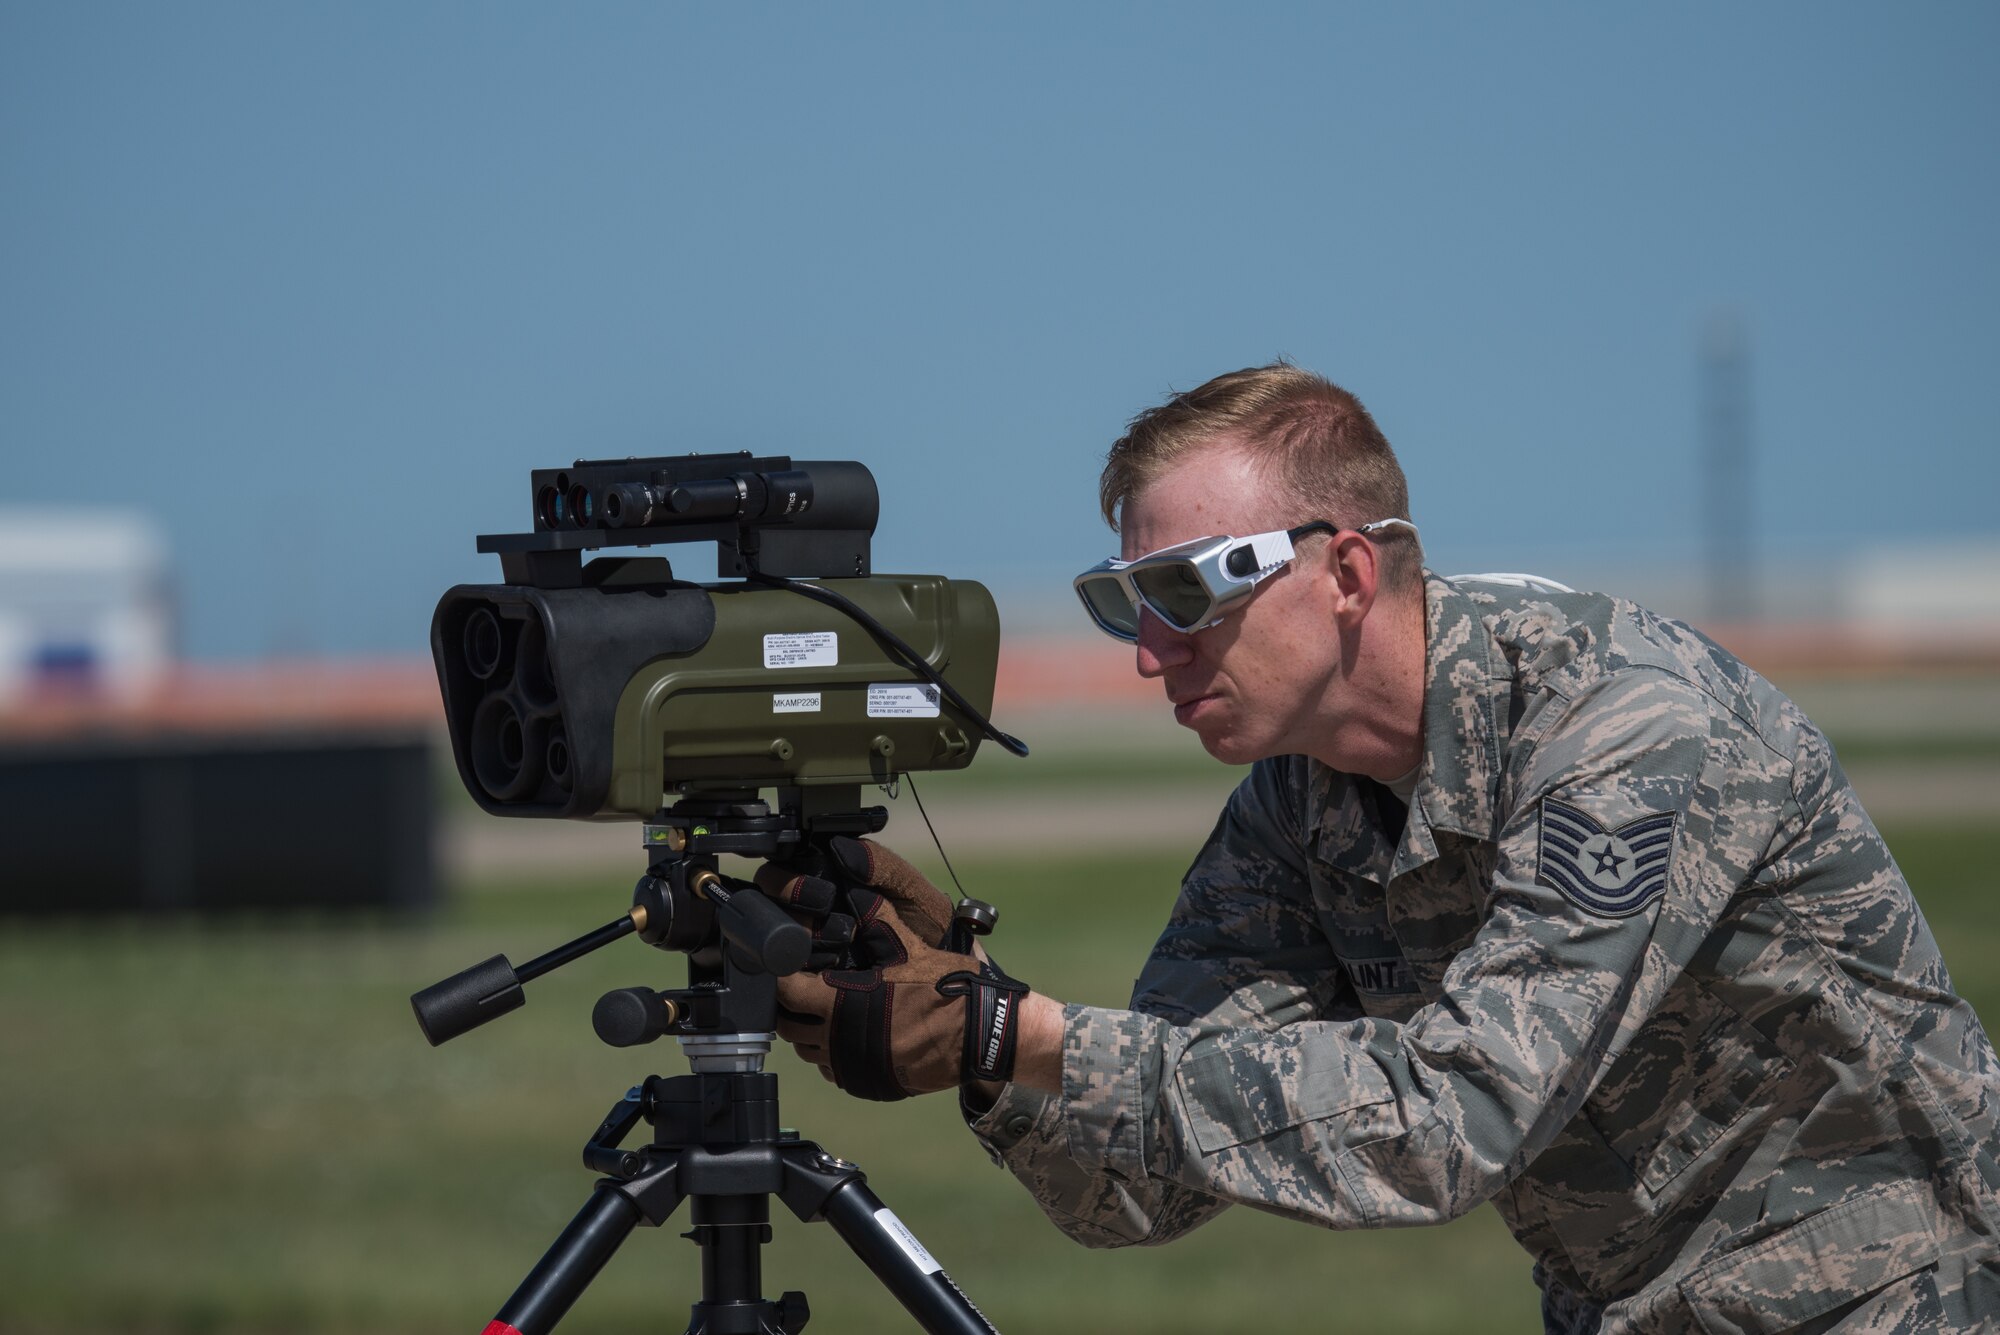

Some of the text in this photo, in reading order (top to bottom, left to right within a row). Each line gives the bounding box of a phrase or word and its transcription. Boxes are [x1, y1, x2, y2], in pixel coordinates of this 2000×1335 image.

[774, 697, 819, 708] MKAMP2296
[1343, 961, 1397, 989] LINT
[986, 998, 1008, 1071] TRUE GRIP
